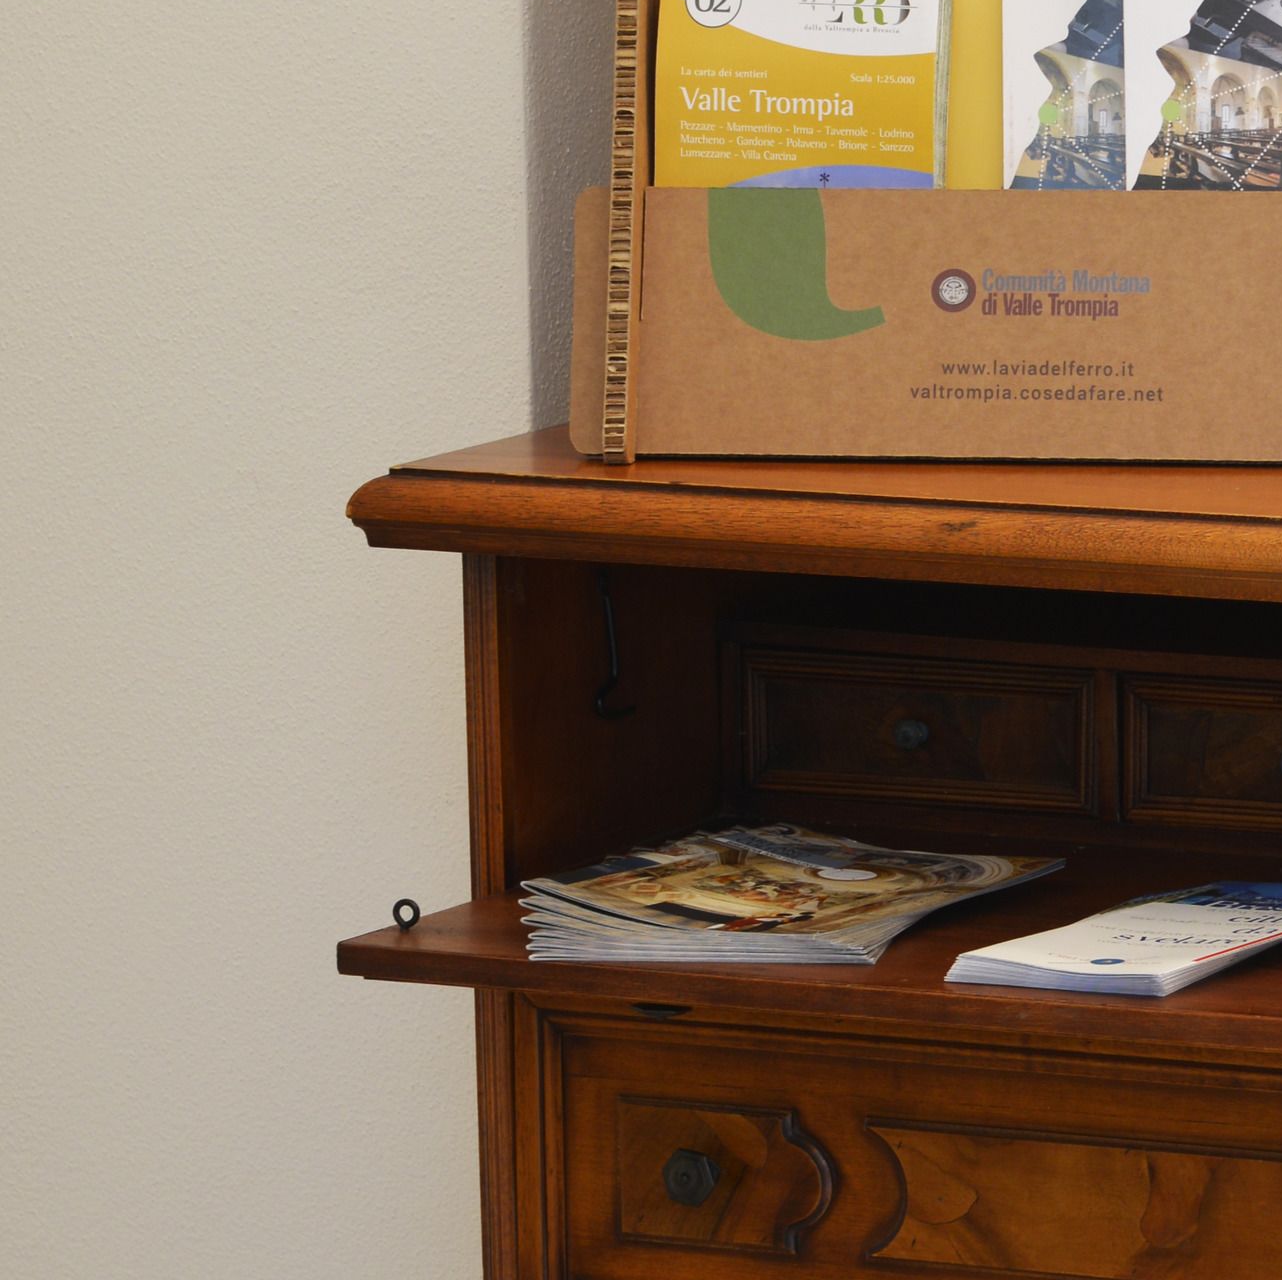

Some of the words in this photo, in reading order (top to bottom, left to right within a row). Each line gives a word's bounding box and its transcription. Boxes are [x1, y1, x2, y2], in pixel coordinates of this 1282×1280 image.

[681, 68, 691, 76] La
[694, 69, 716, 77] carta
[718, 69, 732, 77] dei
[735, 69, 768, 79] sentieri
[850, 73, 872, 83] Scala
[876, 75, 916, 84] 1:25.000
[680, 87, 741, 112] Valle
[749, 89, 854, 121] Trompia
[680, 121, 715, 131] Pezzaze
[727, 123, 782, 134] Marmentino
[793, 126, 814, 134] Irma
[825, 126, 868, 137] Tavernole
[879, 128, 914, 138] Lodrino
[680, 134, 725, 145] Marcheno
[736, 136, 775, 147] Gardone
[786, 138, 827, 149] Polaveno
[839, 140, 868, 151] Brione
[879, 142, 914, 152] Sarezzo
[680, 148, 731, 159] Lumezzane
[741, 150, 761, 160] Villa
[764, 151, 797, 161] Carcina
[982, 268, 1066, 293] Comunità
[1072, 269, 1150, 293] Montana
[982, 294, 997, 316] di
[1003, 294, 1043, 316] Valle
[1048, 293, 1119, 320] Trompia
[942, 360, 1134, 377] www.laviadelferro.it
[910, 384, 1164, 403] valtrompia.cosedafare.net
